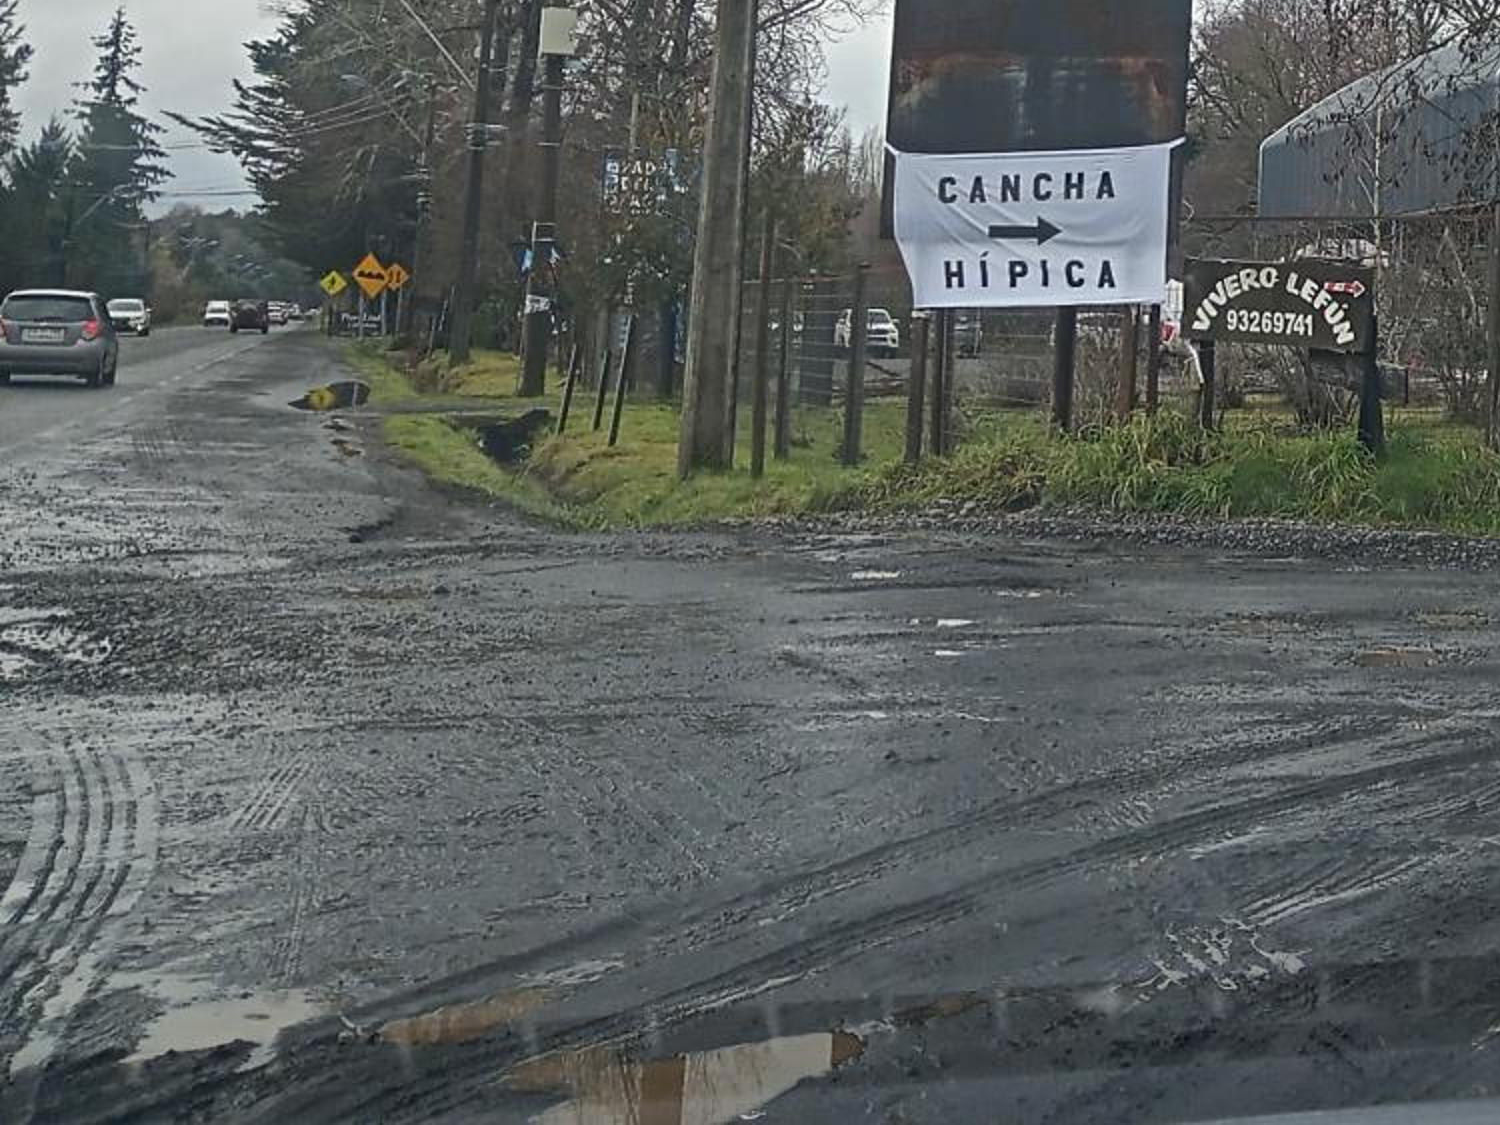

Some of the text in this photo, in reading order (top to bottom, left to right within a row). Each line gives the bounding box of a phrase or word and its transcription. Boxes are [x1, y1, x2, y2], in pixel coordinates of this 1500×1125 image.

[938, 171, 1115, 204] CANCHA
[944, 251, 1115, 289] HÍPICA
[1192, 267, 1279, 330] VIVERO
[1226, 309, 1313, 336] 93269741
